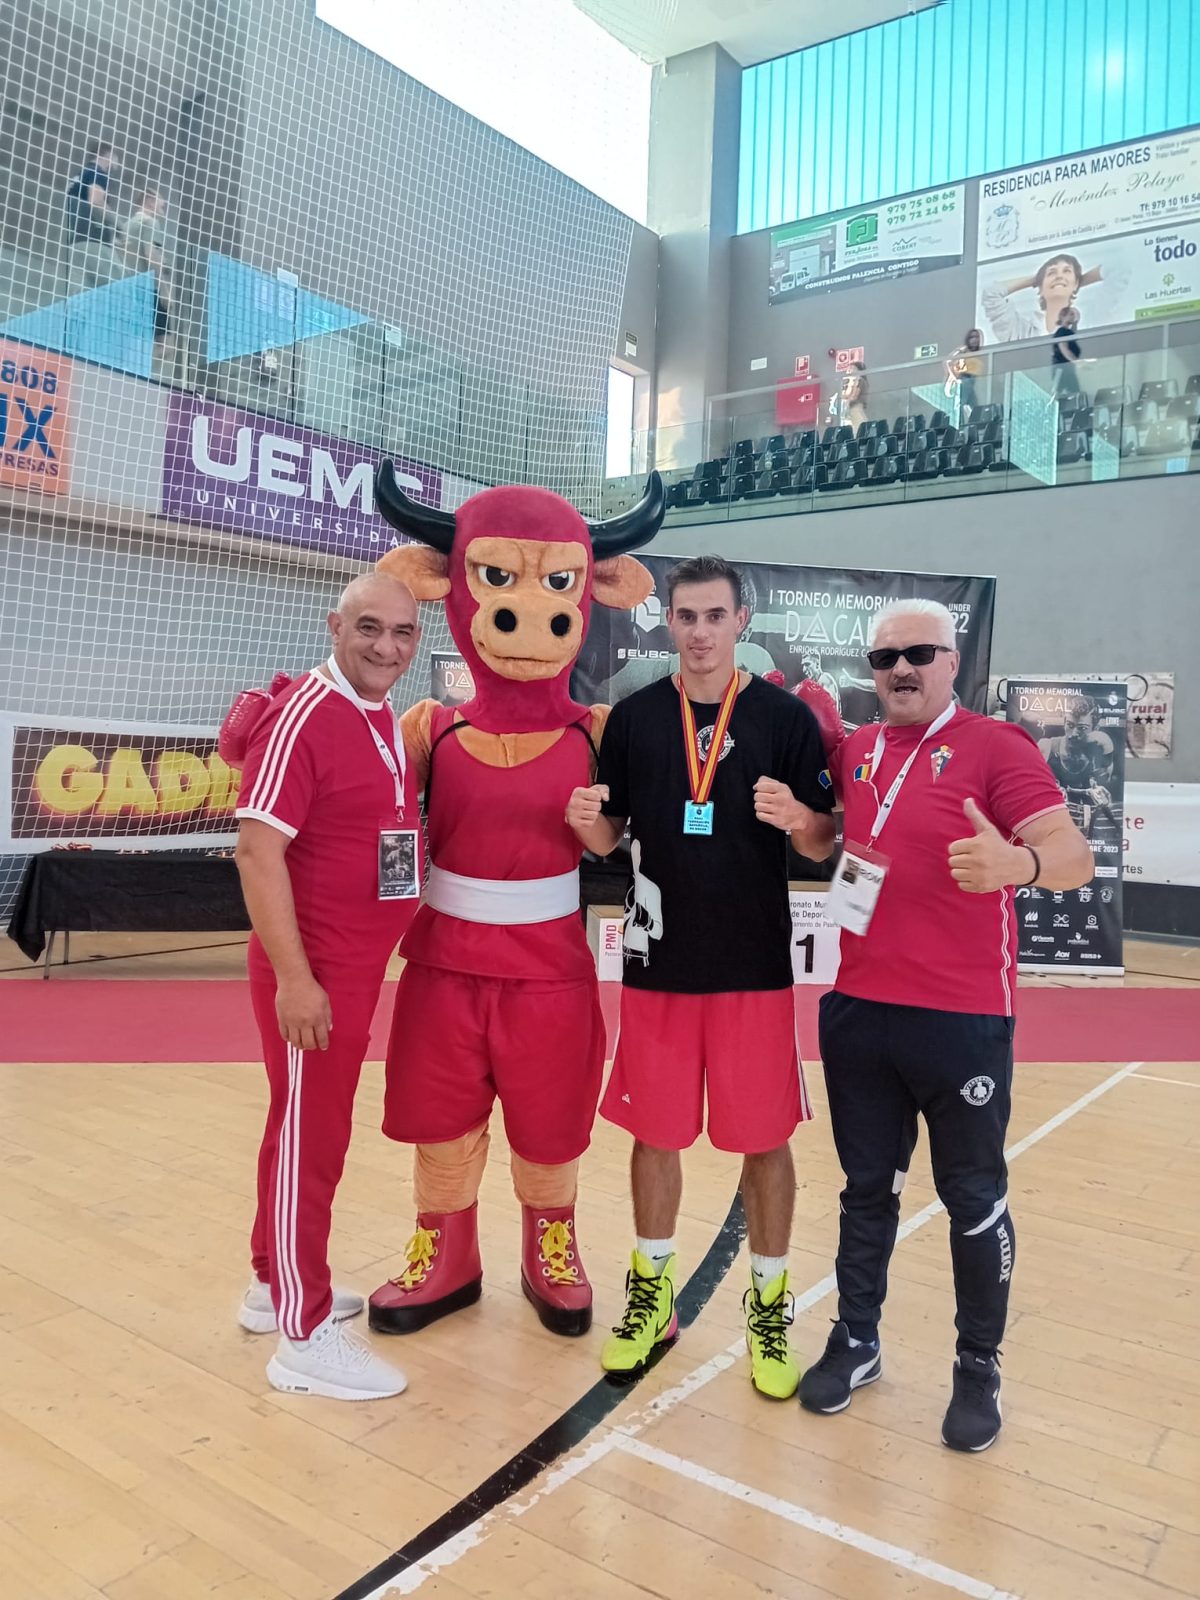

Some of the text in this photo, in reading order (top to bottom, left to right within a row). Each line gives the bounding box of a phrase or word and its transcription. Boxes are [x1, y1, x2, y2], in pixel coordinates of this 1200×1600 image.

[984, 146, 1151, 198] RESIDENCIA PARA MAYORES
[887, 189, 957, 216] 979 75 08 68
[887, 213, 906, 226] 979
[909, 210, 923, 222] 72
[941, 201, 956, 213] 65
[1155, 234, 1178, 244] tienes
[1153, 239, 1197, 263] todo
[851, 266, 885, 280] PALENCIA
[887, 259, 920, 271] CONTIGO
[1144, 292, 1158, 300] Las
[1159, 286, 1192, 297] Huertas
[0, 452, 59, 477] RESAS
[777, 589, 832, 608] TORNEO
[948, 603, 971, 613] UNDER
[789, 644, 819, 655] ENRIQUE
[1014, 686, 1044, 696] TORNEO
[1045, 687, 1084, 697] MEMORIAL
[1132, 702, 1167, 714] rural
[1125, 817, 1145, 830] te
[1121, 838, 1130, 852] a
[1121, 865, 1143, 875] rtes
[790, 900, 812, 909] ronato
[791, 910, 800, 918] de
[605, 924, 617, 950] PMD
[796, 934, 815, 973] 1
